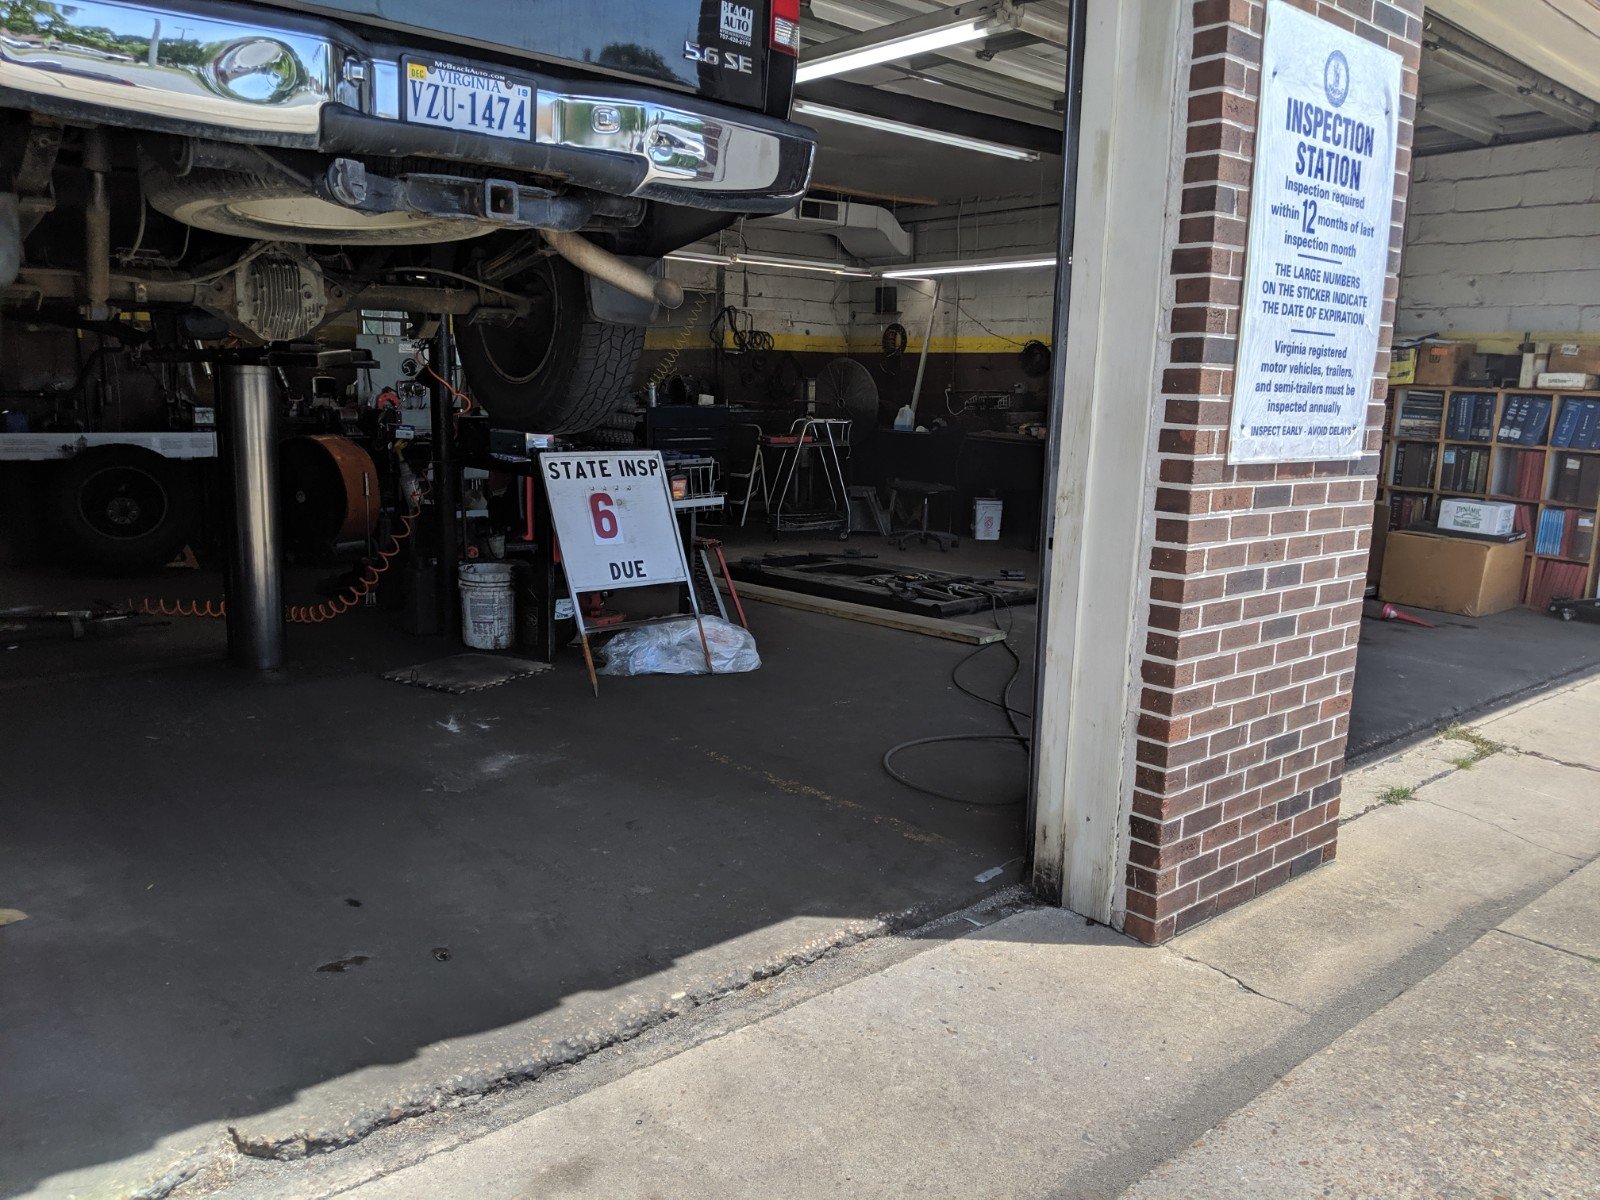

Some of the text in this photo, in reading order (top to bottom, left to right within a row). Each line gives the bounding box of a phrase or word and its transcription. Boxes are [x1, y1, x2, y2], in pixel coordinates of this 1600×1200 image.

[721, 1, 753, 20] BEACH
[724, 16, 749, 32] AUTO
[683, 40, 752, 74] 5.6 SE
[411, 68, 424, 79] DEC
[438, 70, 501, 93] VIRGINIA
[517, 88, 528, 97] 19
[410, 79, 526, 133] VZU-1474
[1286, 97, 1375, 157] INSPECTION
[1295, 141, 1361, 191] STATION
[1285, 175, 1365, 209] Inspection required
[1271, 199, 1375, 238] within 12 months of last
[1284, 230, 1357, 258] inspection month
[1275, 263, 1360, 289] THE LARGE NUMBERS
[1262, 281, 1368, 308] ON THE STICKER INDICATE
[1262, 301, 1364, 325] THE DATE OF EXPIRATION
[1275, 340, 1347, 359] Virginia registered
[1261, 362, 1354, 378] motor vehicles, trailers,
[1255, 380, 1355, 396] and semi-trailers must be
[1267, 400, 1342, 416] inspected annually
[1250, 425, 1281, 436] INSPECT
[1282, 425, 1303, 436] EARLY
[1307, 425, 1328, 436] AVOID
[1328, 425, 1351, 436] DELAYS
[548, 459, 658, 480] STATE INSP
[589, 492, 619, 540] 6
[609, 560, 646, 580] DUE
